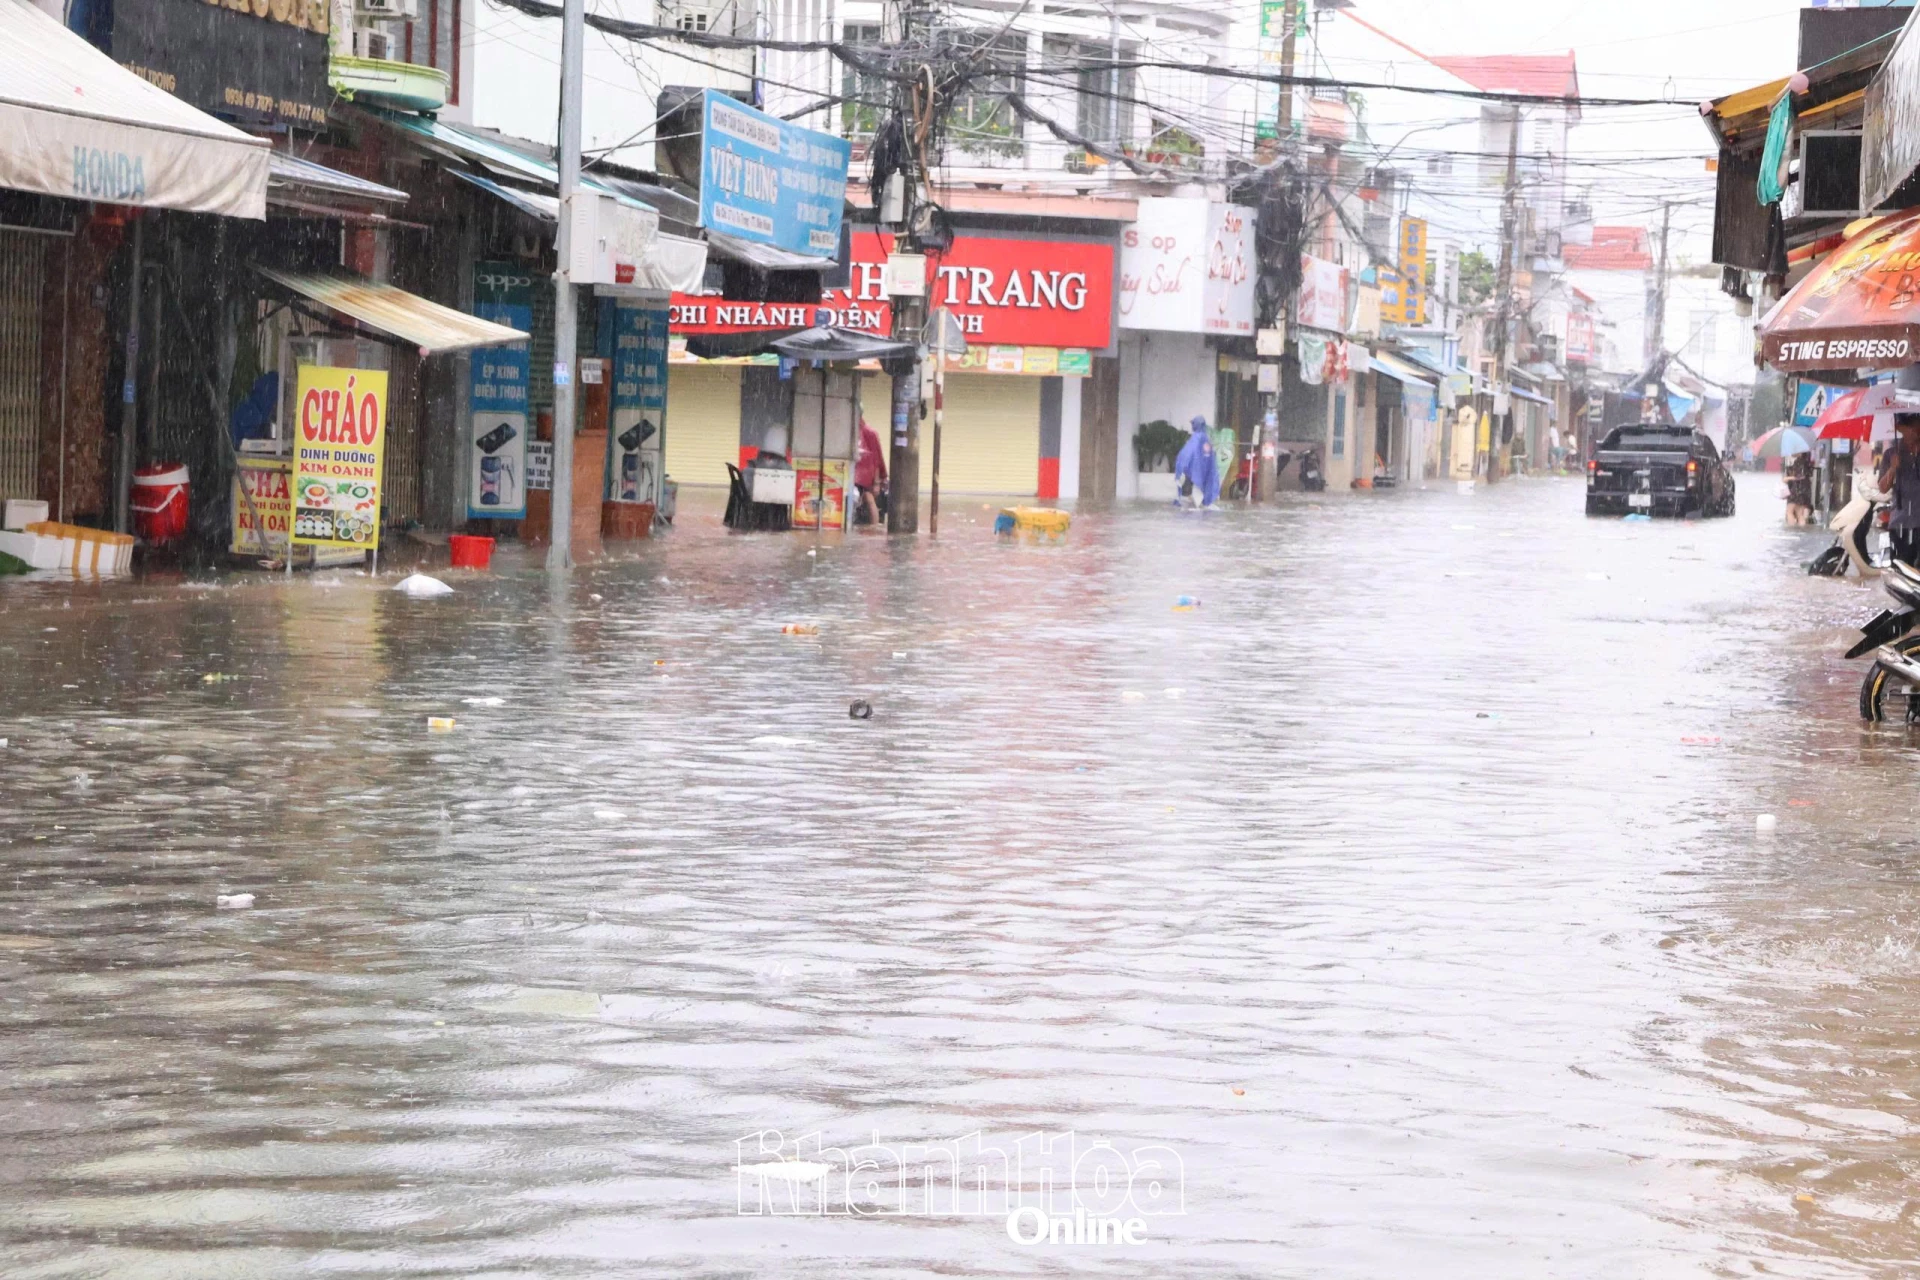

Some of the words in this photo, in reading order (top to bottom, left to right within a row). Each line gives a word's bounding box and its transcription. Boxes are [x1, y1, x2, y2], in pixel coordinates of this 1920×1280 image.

[74, 145, 145, 200] HONDA
[710, 140, 742, 201] VIỆT
[476, 273, 532, 293] oppo
[938, 265, 1088, 311] TRANG
[668, 304, 707, 325] CHI
[715, 302, 806, 327] NHÁNH
[1778, 339, 1825, 362] STING
[1827, 338, 1909, 360] ESPRESSO
[302, 374, 378, 446] CHÁO
[300, 447, 330, 461] DINH
[300, 462, 328, 474] KIM
[332, 465, 374, 478] OANH
